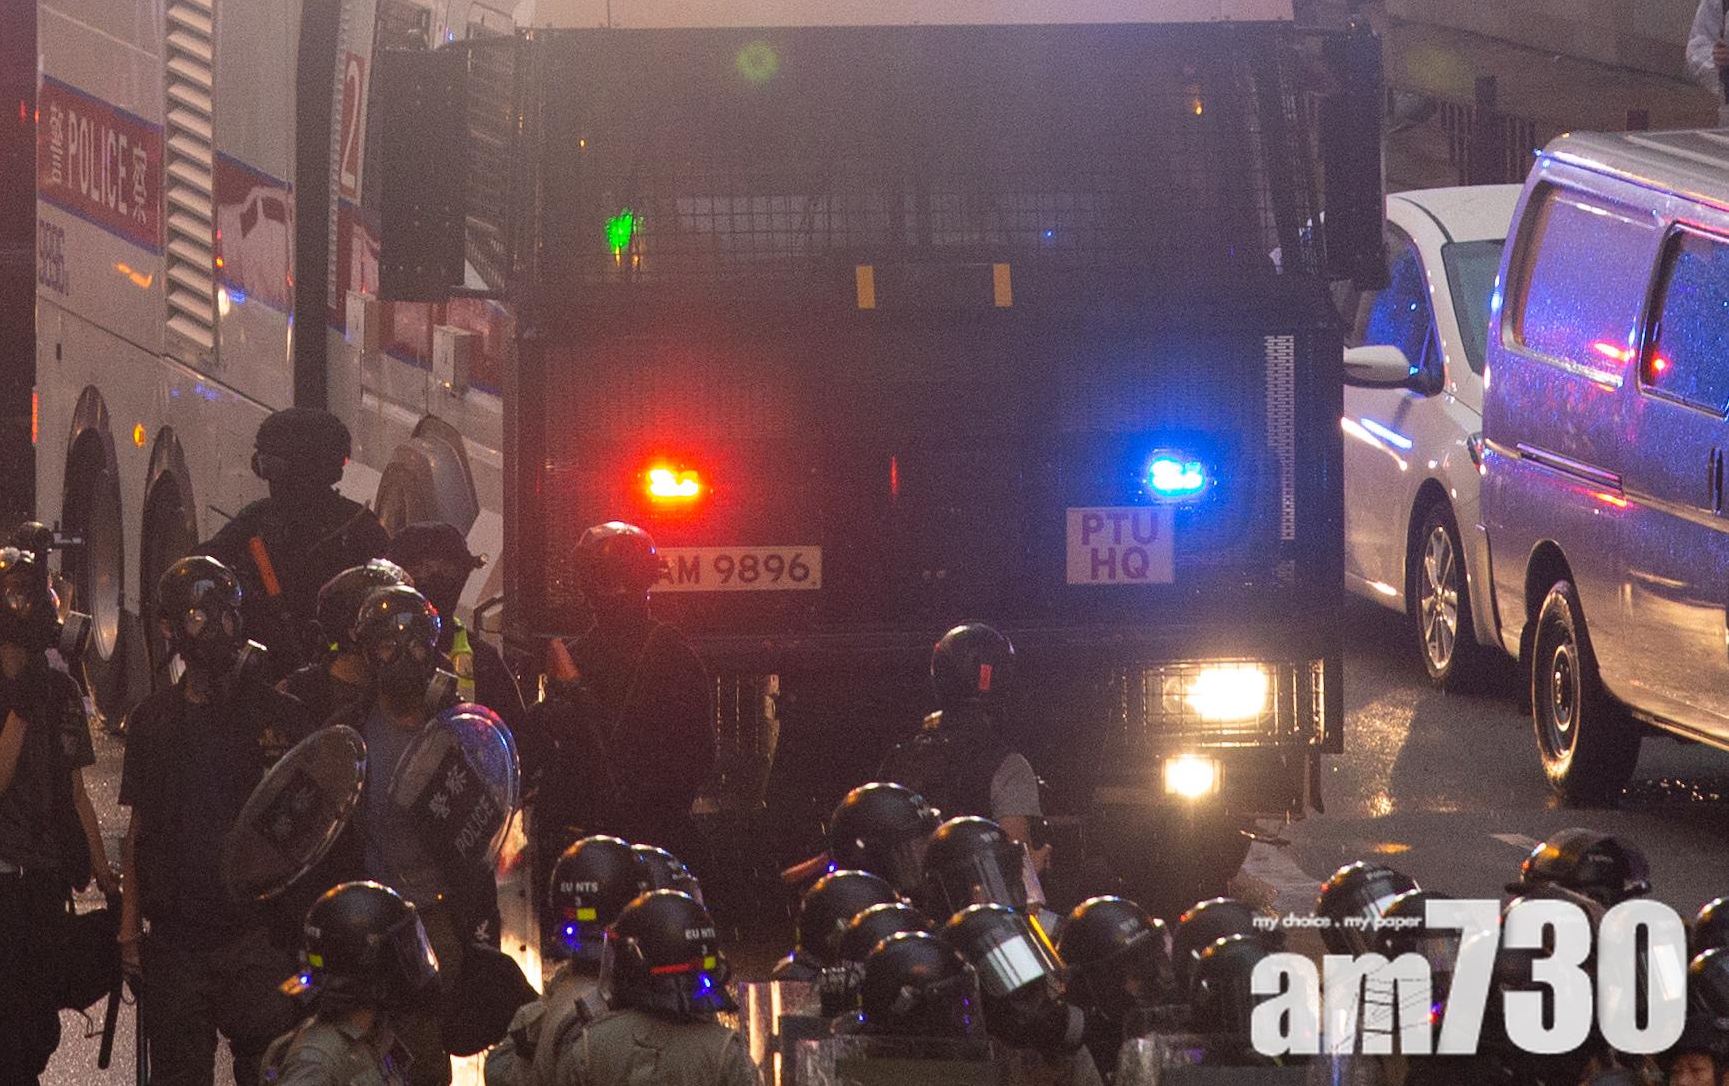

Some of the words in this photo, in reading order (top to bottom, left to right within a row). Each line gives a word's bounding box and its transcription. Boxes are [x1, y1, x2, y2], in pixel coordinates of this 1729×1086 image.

[340, 60, 361, 190] 2
[68, 110, 128, 215] POLICE
[1081, 513, 1160, 547] PTU
[712, 552, 811, 585] 9896
[1090, 546, 1152, 581] HQ
